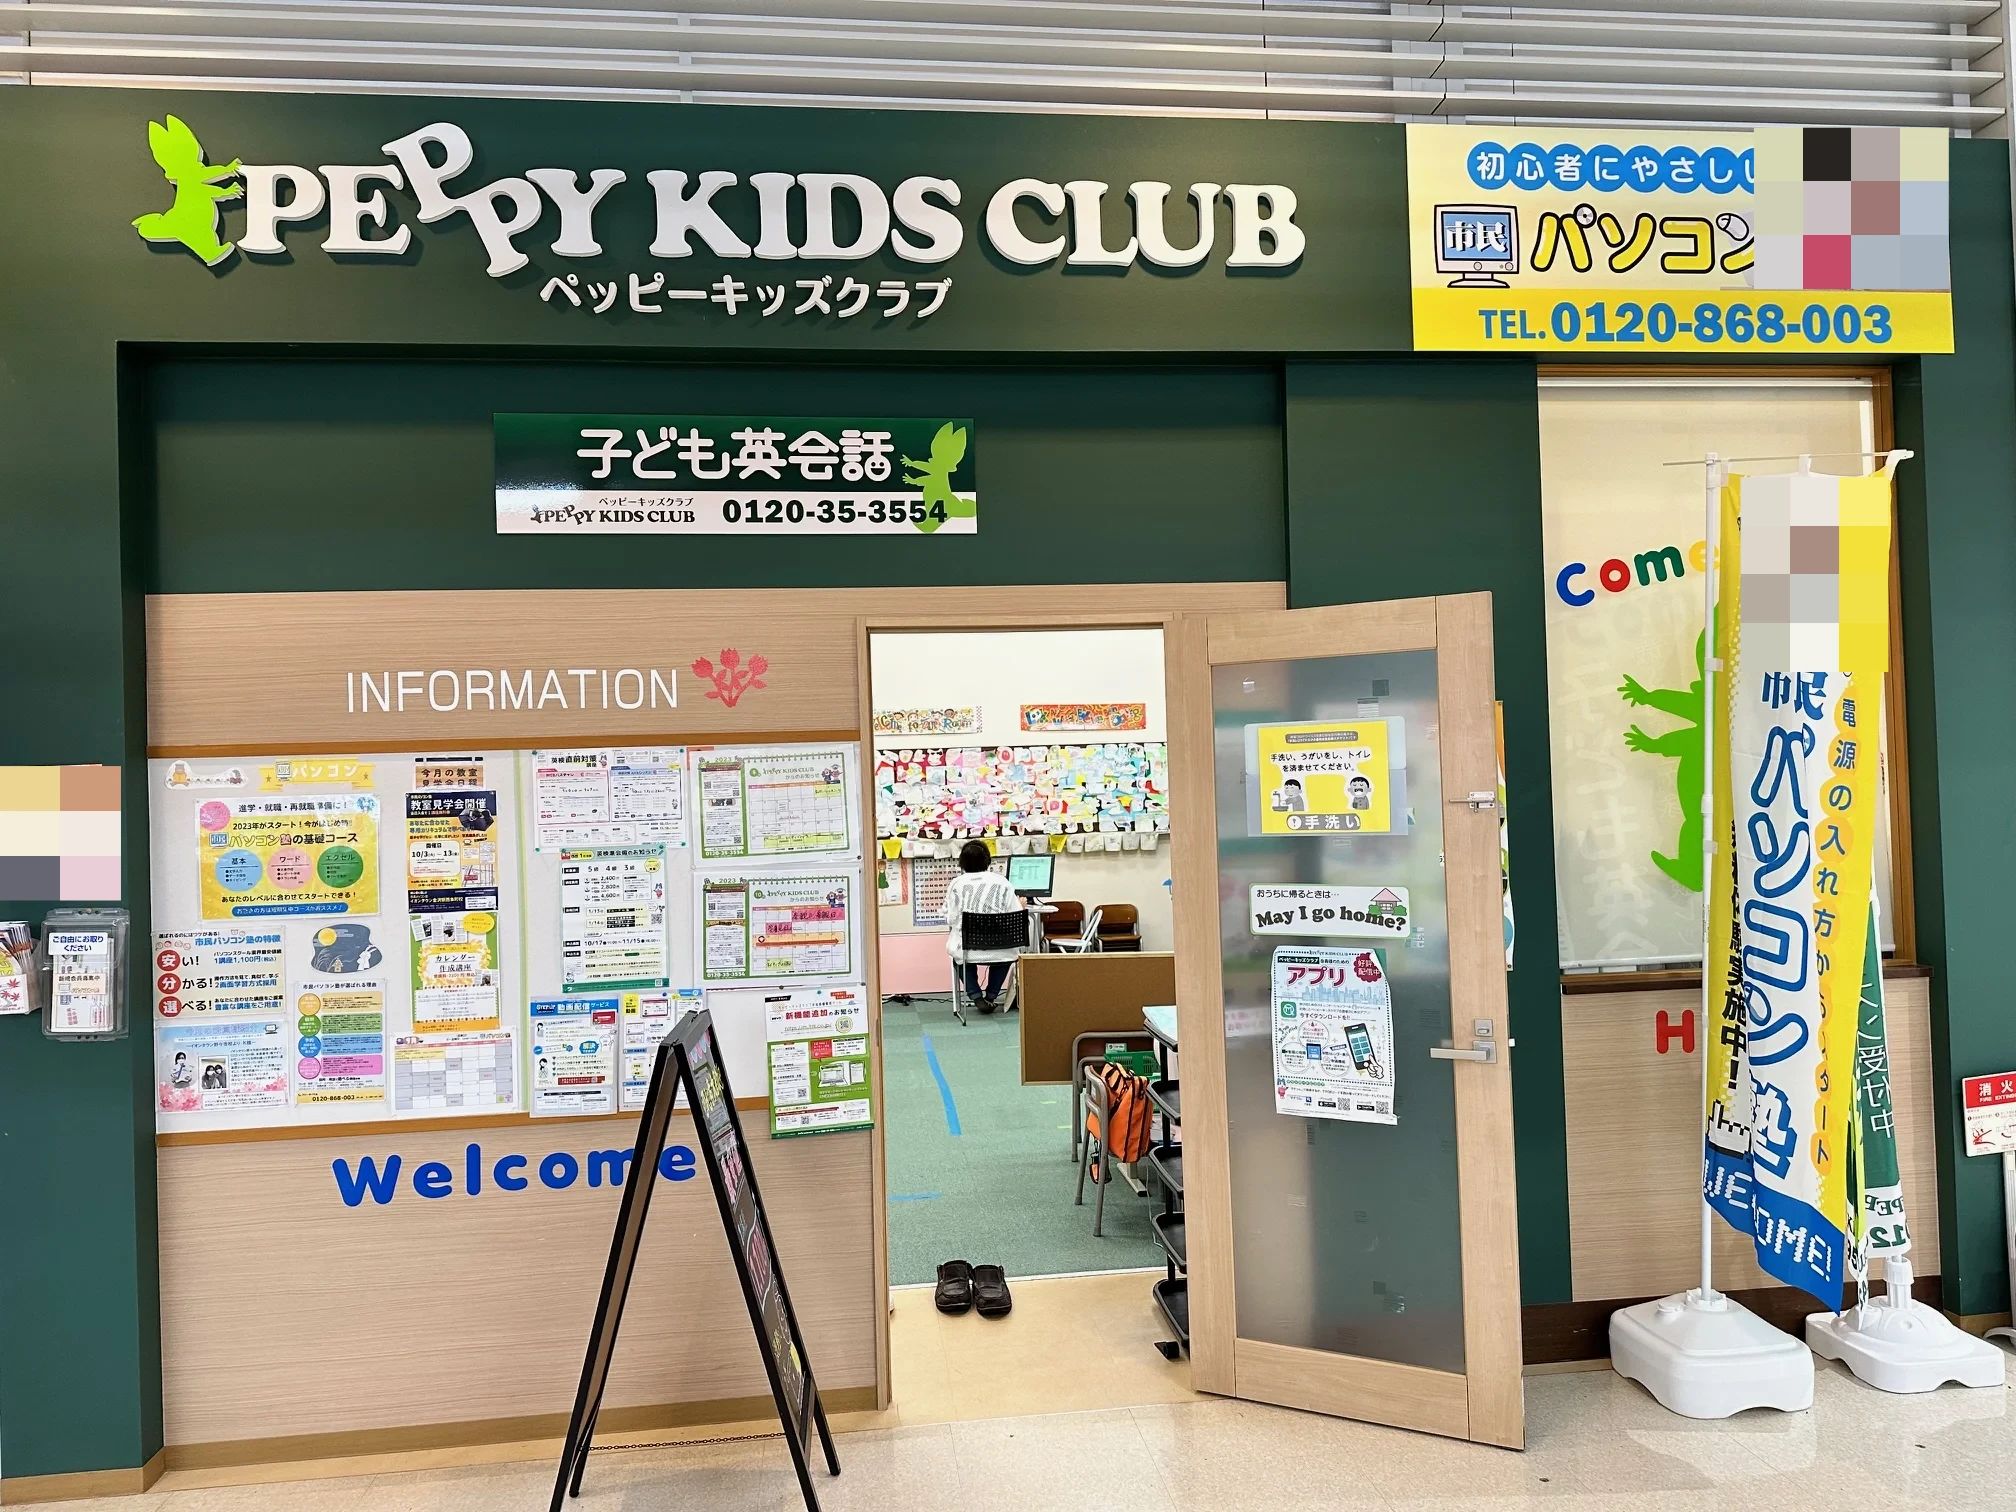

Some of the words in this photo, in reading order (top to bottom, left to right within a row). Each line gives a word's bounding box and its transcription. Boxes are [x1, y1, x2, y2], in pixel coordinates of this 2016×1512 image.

[237, 121, 627, 278] PEPPY
[646, 169, 964, 265] KIDS
[985, 177, 1306, 269] CLUB
[1445, 220, 1508, 252] 市民
[539, 271, 953, 318] ペッピーキッズクラブ
[1478, 309, 1546, 340] TEL.
[1550, 302, 1893, 344] 0120-868-003
[576, 426, 895, 482] 子ども英会話
[598, 497, 694, 507] ペッピーキッズクラブ
[722, 499, 948, 524] 0120-35-3554
[543, 504, 596, 525] PEPPY
[599, 510, 645, 523] KIDS
[647, 510, 695, 523] CLUB
[347, 669, 678, 713] INFORMATION
[1270, 751, 1371, 761] 手洗い、うがいをし、トイレ
[421, 768, 478, 778] 今月の教室
[1282, 763, 1355, 772] を済ませてください。
[410, 798, 487, 811] 教室見学会開催
[1305, 815, 1360, 829] 手洗い
[1256, 910, 1294, 928] May
[1299, 906, 1307, 920] I
[1312, 911, 1335, 922] go
[1340, 906, 1407, 931] home?
[161, 954, 199, 968] 安い!
[161, 976, 213, 990] 分かる!
[1286, 966, 1345, 987] アプリ
[162, 1000, 212, 1014] 選べる!
[332, 1143, 697, 1207] Welcome
